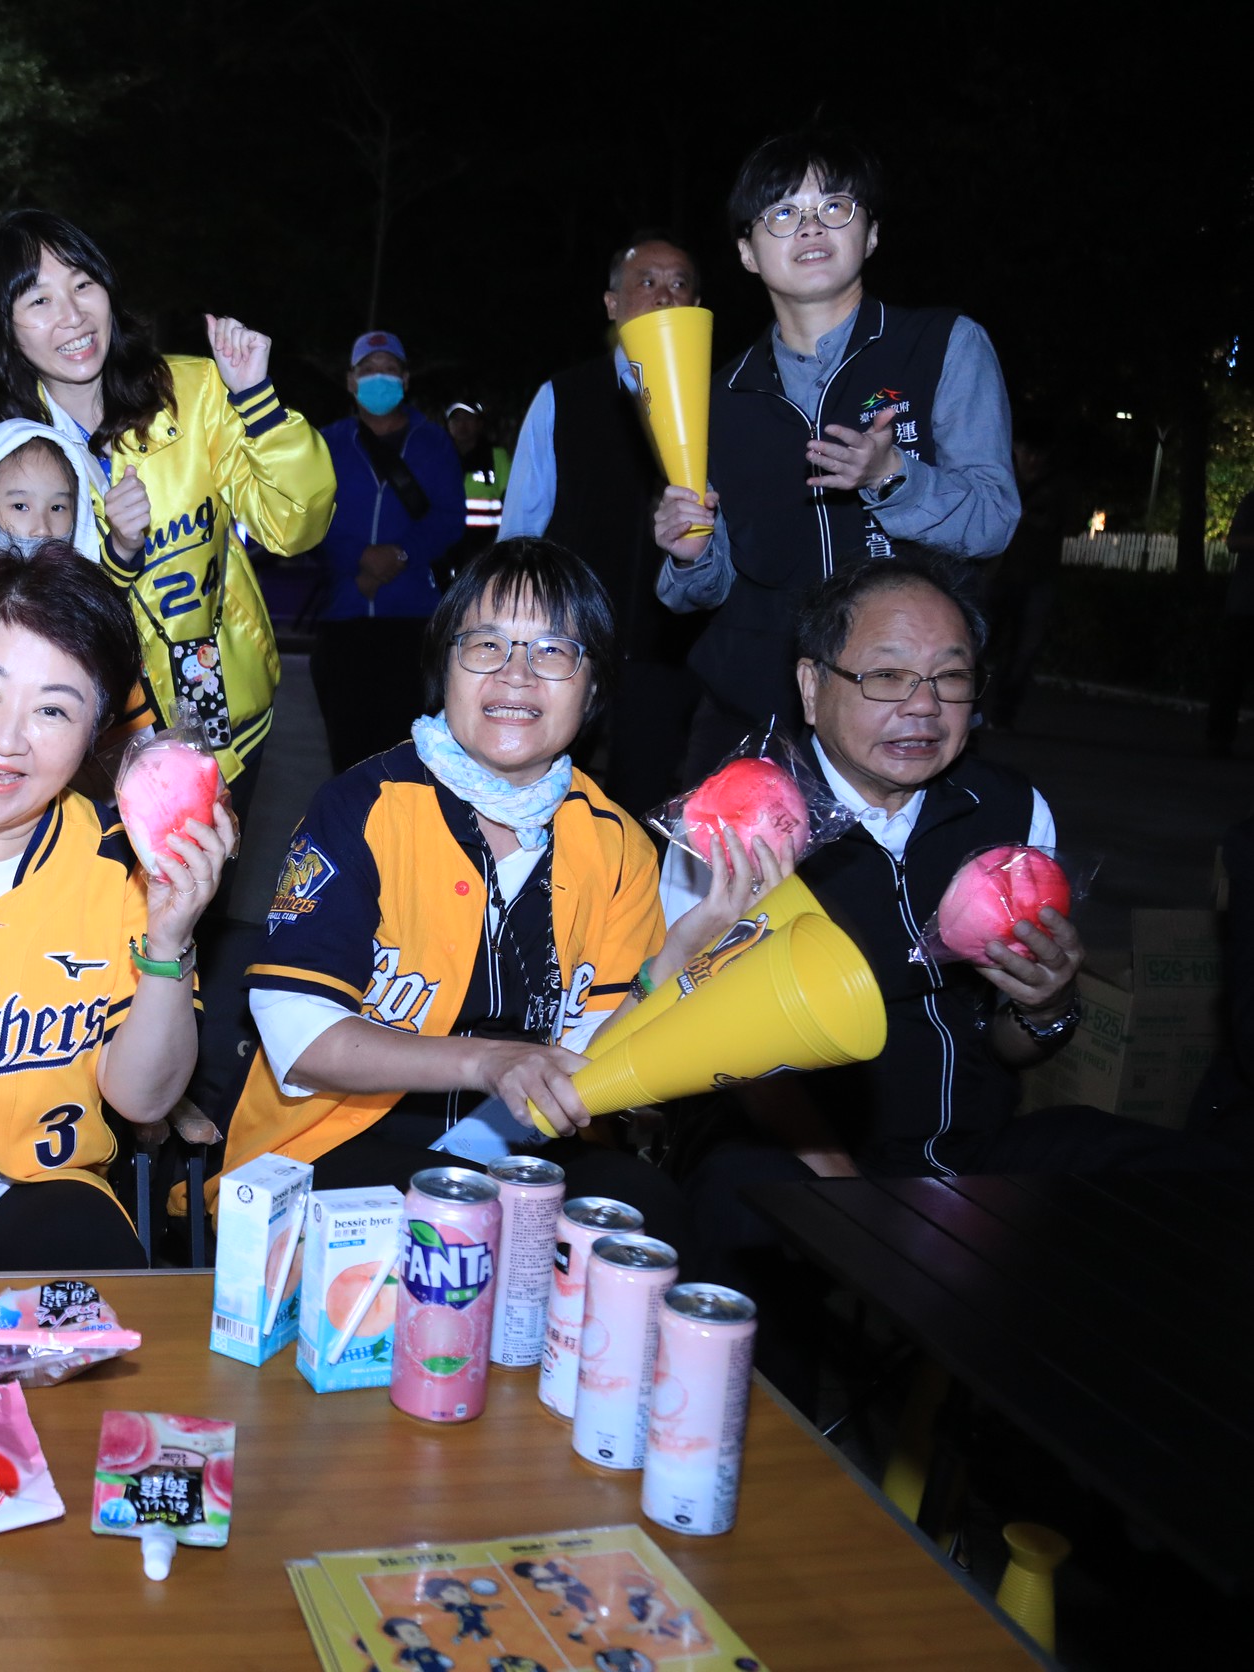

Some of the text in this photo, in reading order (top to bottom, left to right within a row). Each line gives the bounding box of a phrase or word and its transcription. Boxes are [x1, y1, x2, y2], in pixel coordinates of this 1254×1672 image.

[34, 1103, 86, 1169] 3
[334, 1218, 367, 1229] bessie
[134, 1498, 189, 1516] おいしい
